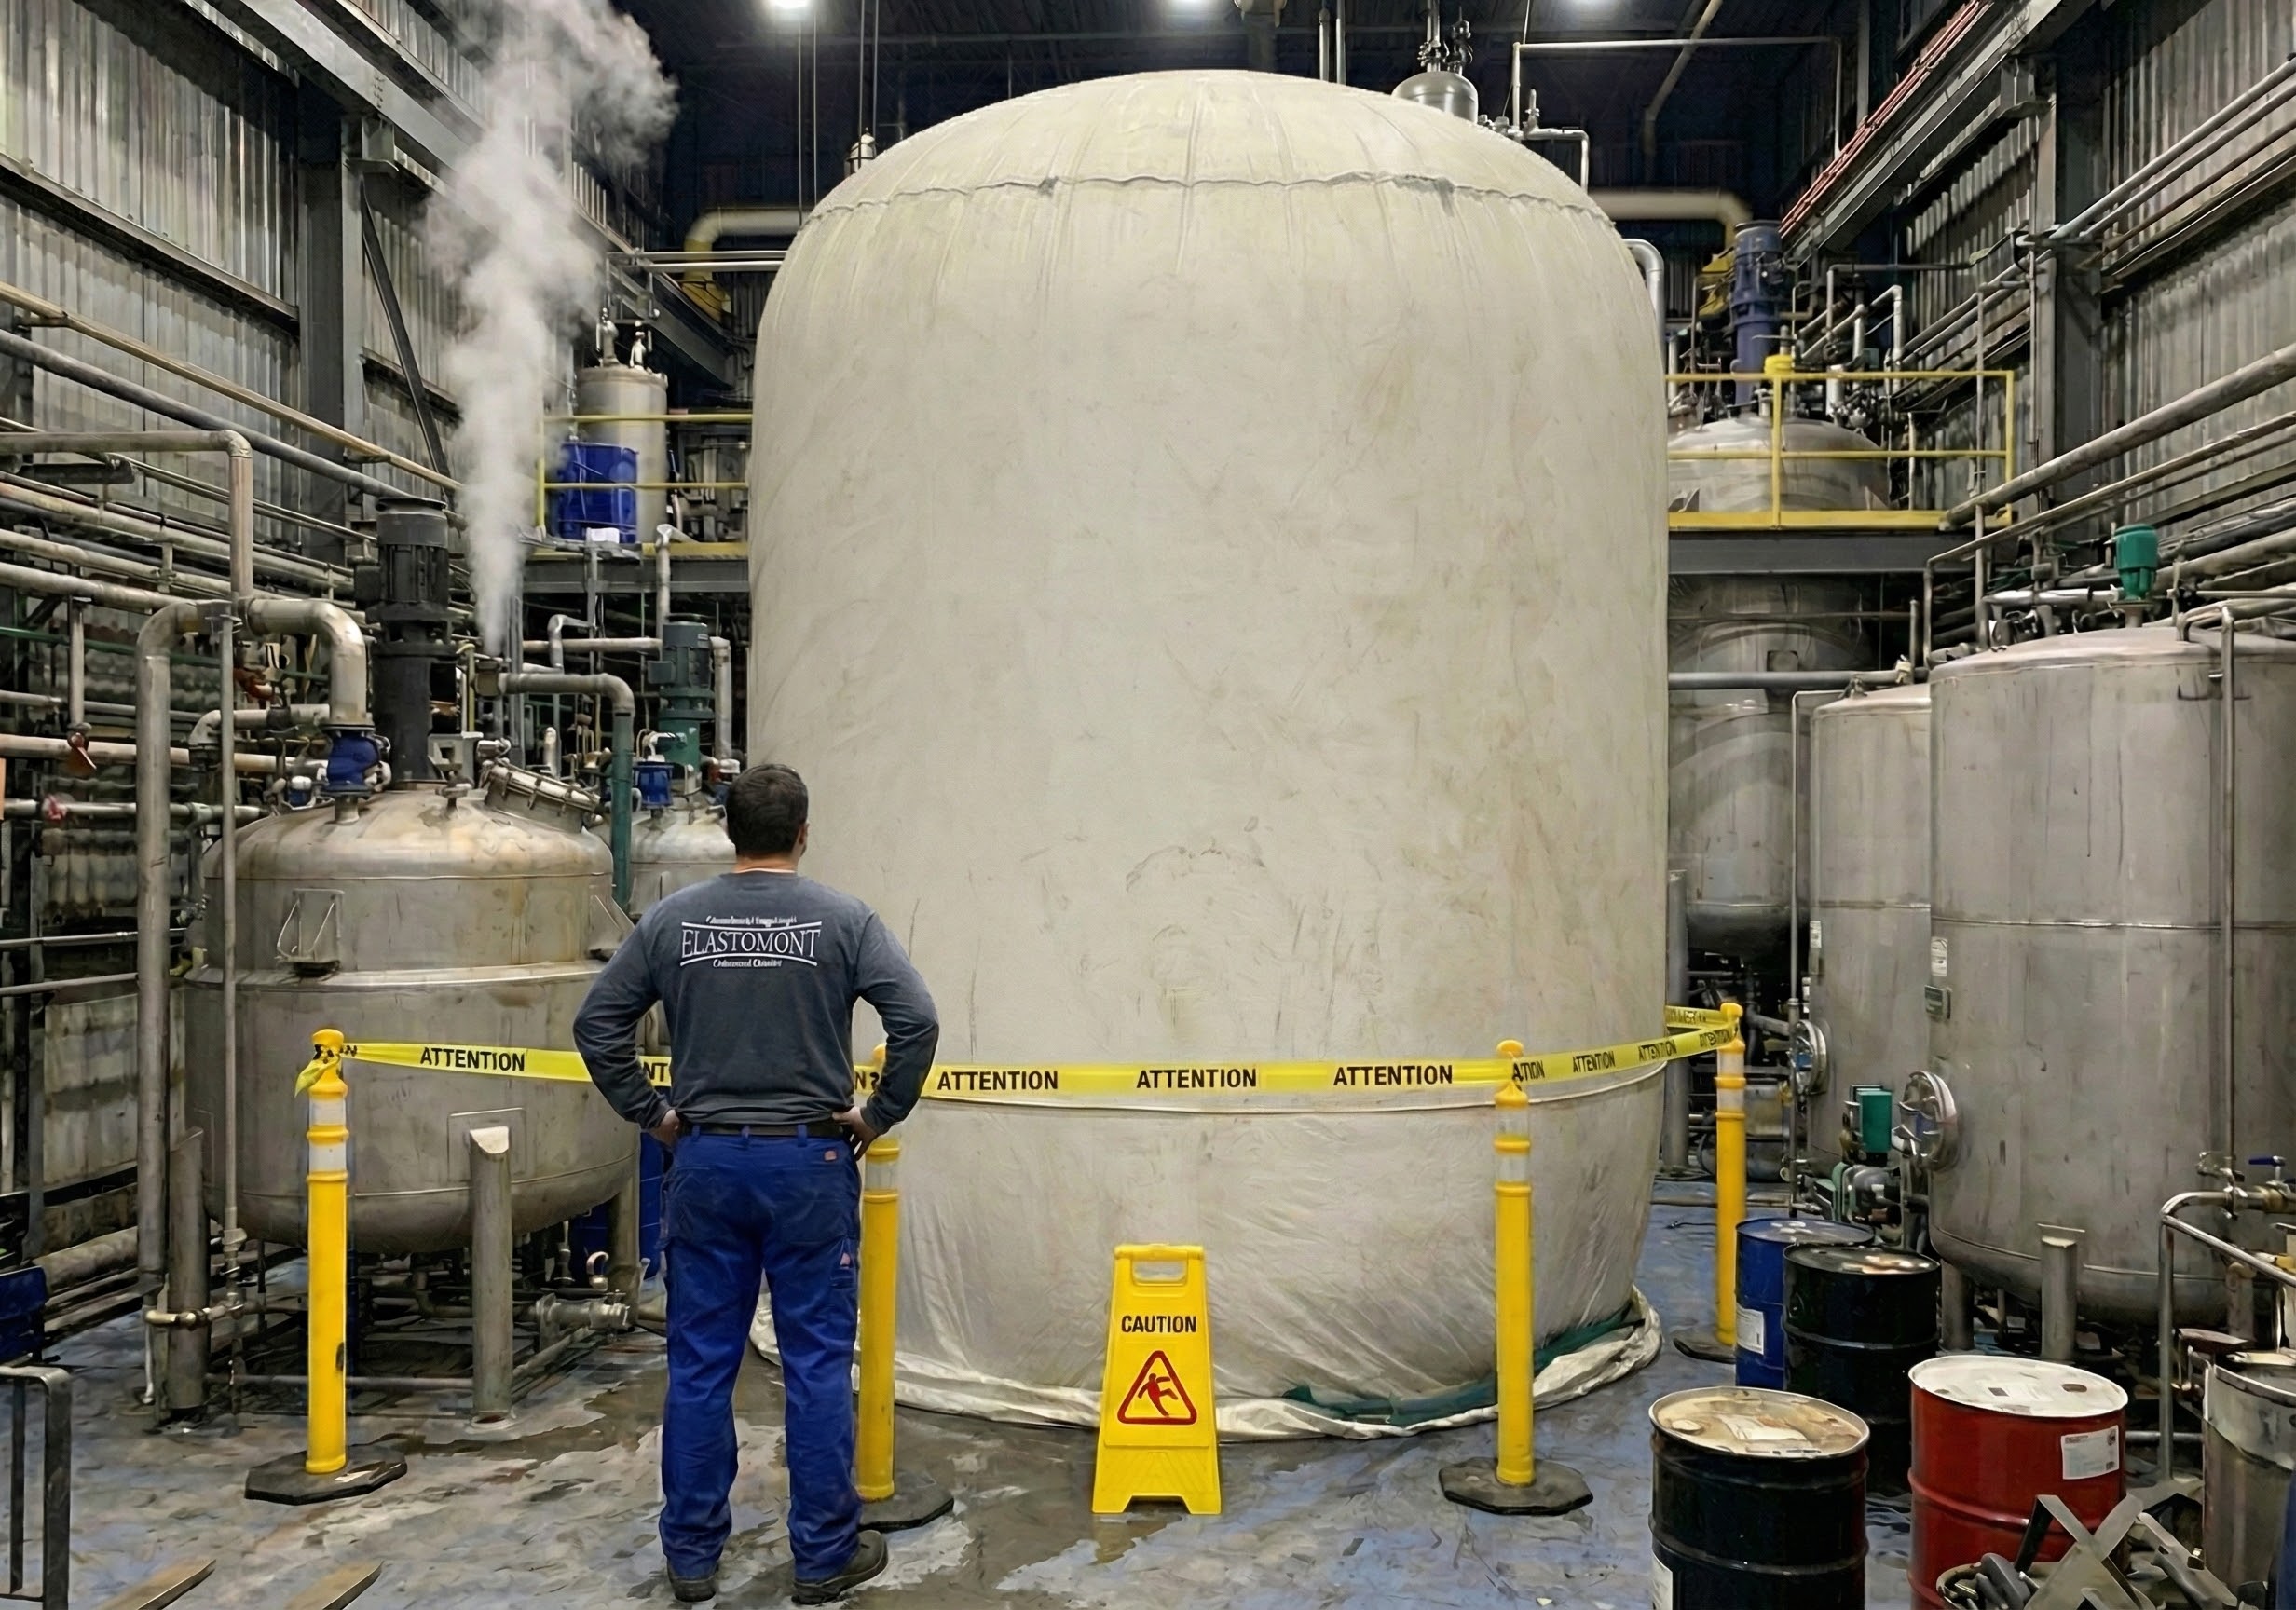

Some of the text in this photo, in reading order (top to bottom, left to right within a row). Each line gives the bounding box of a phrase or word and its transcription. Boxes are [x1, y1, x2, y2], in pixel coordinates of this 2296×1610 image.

[681, 928, 821, 959] ELASTOMONT
[419, 1046, 526, 1072] ATTENTION
[937, 1070, 1059, 1091] ATTENTION
[1136, 1068, 1257, 1089] ATTENTION
[1332, 1064, 1454, 1086] ATTENTION
[1121, 1315, 1196, 1333] CAUTION
